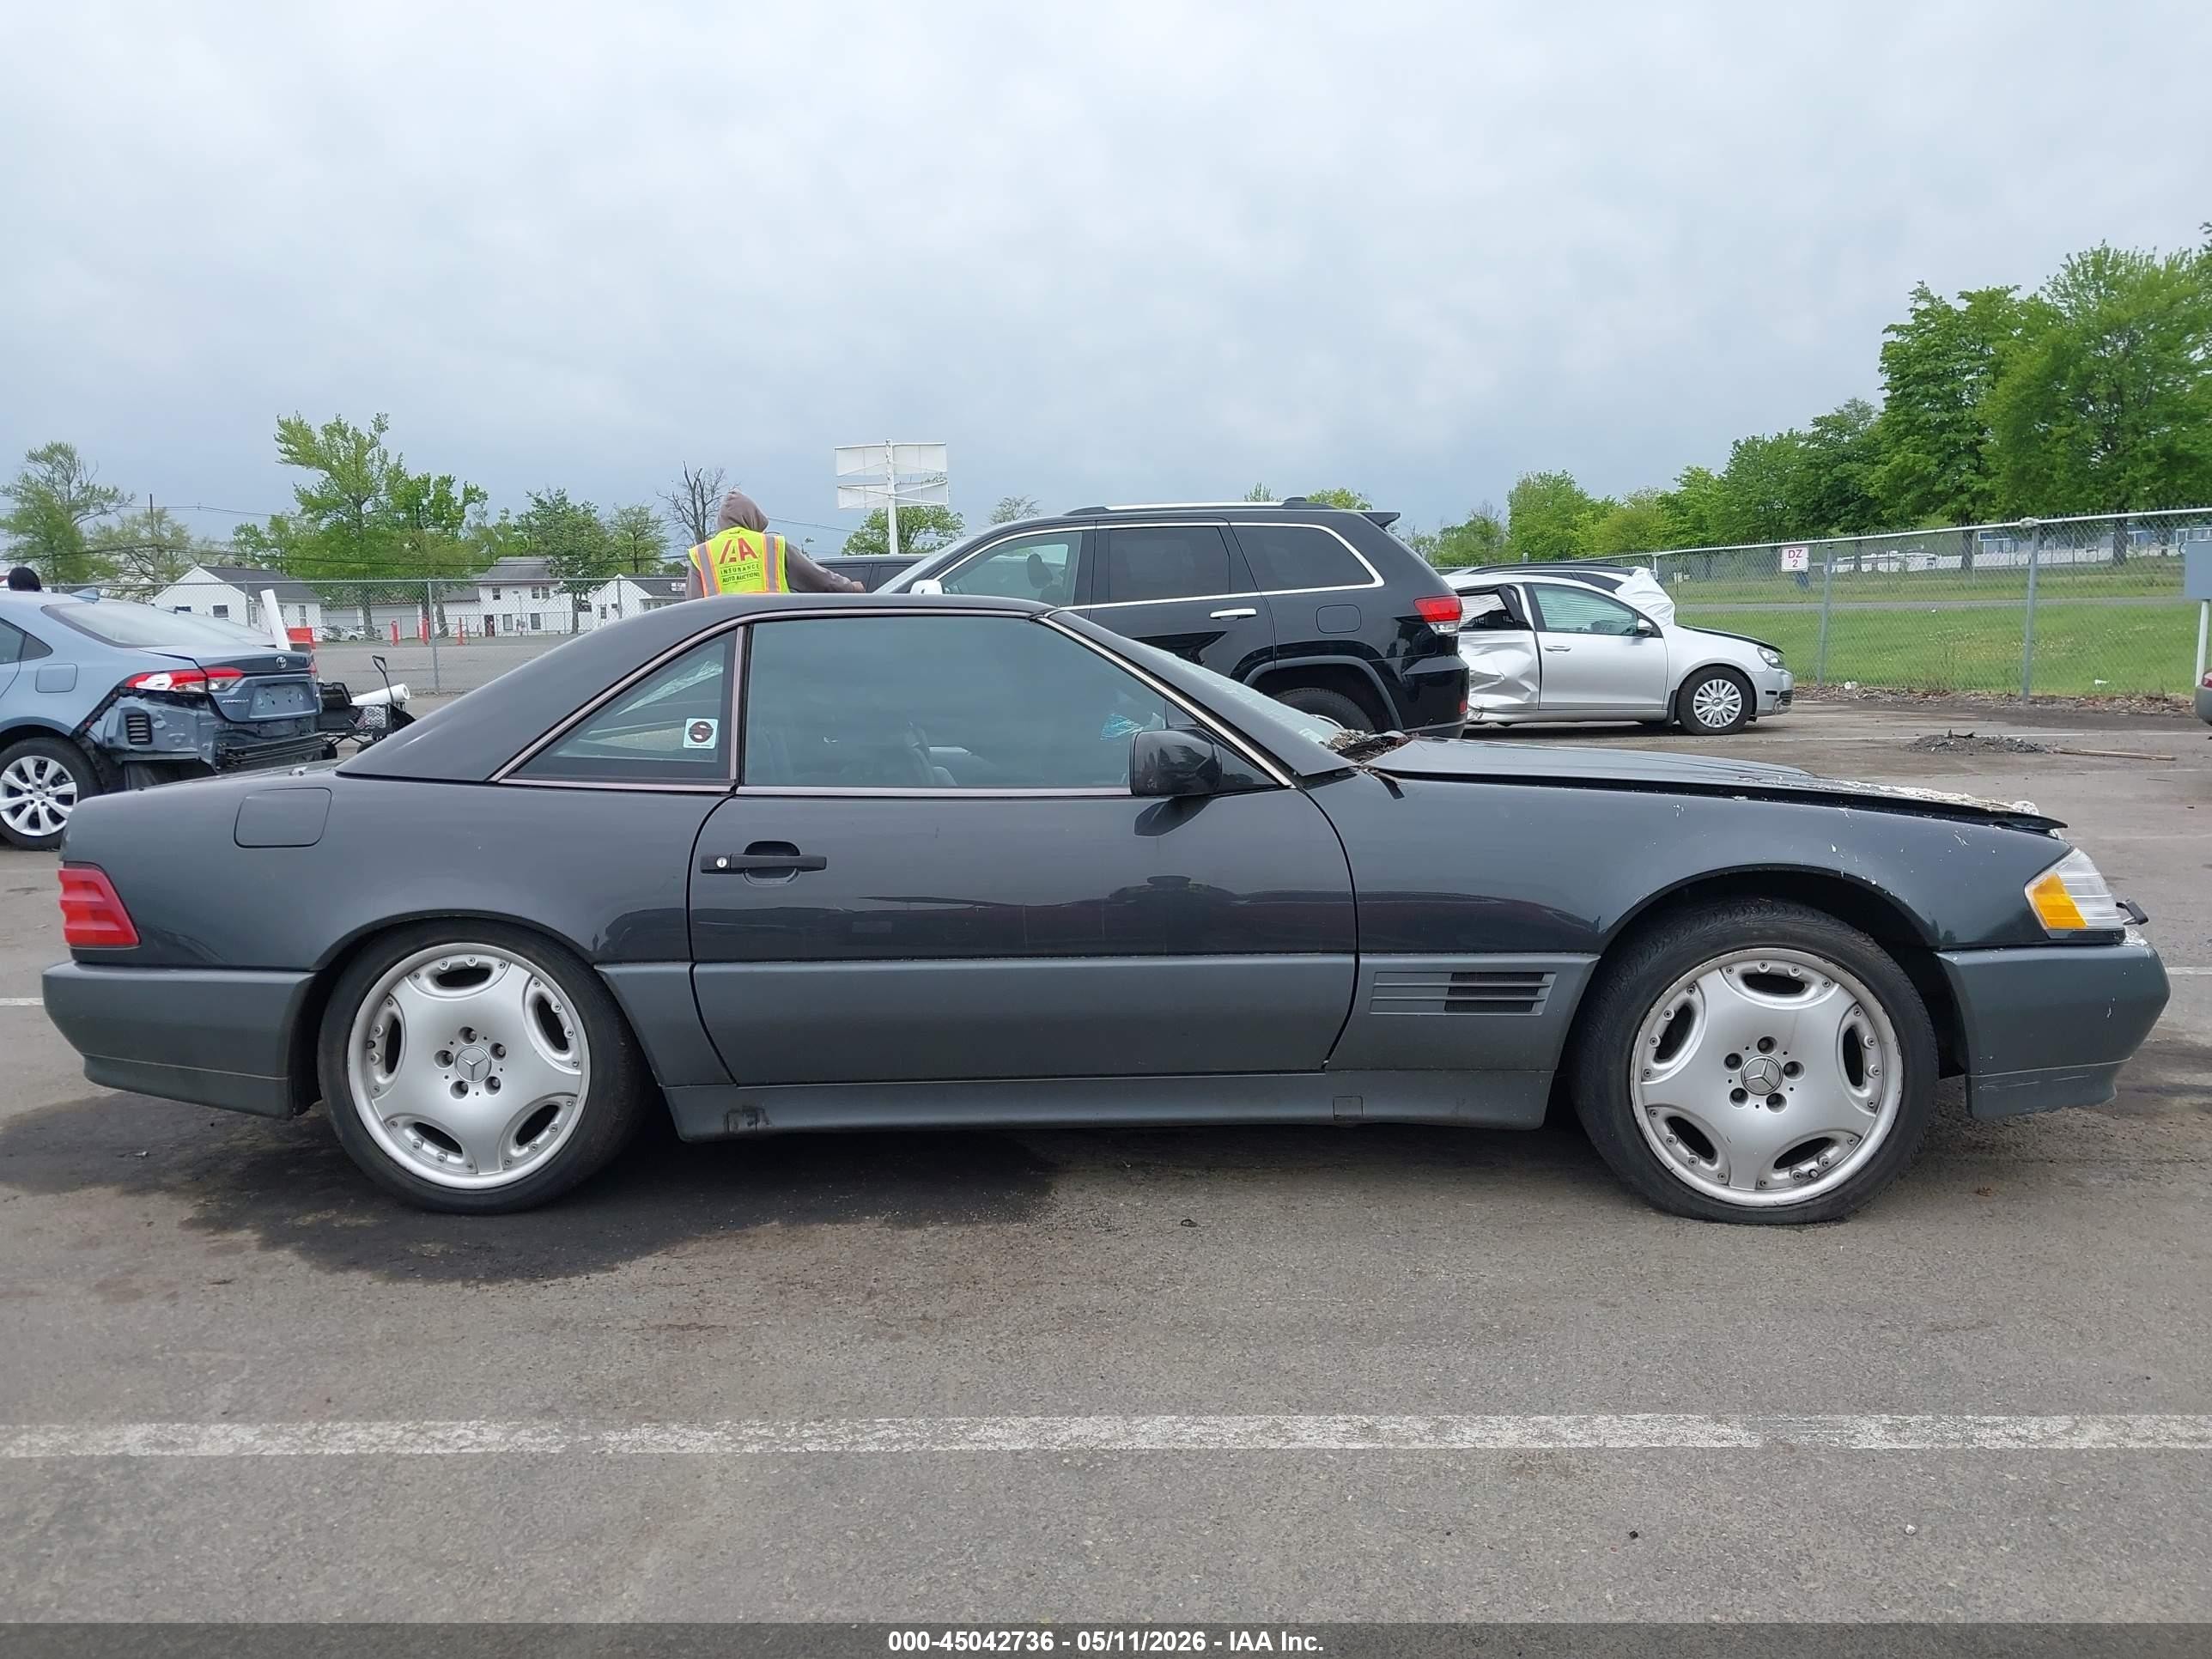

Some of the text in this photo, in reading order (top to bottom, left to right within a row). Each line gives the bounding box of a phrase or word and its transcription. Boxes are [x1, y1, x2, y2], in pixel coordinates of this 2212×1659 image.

[1788, 549, 1802, 558] DZ
[1792, 559, 1798, 568] 2
[720, 563, 760, 574] INSURANCE
[736, 571, 760, 580] AUCTIONS
